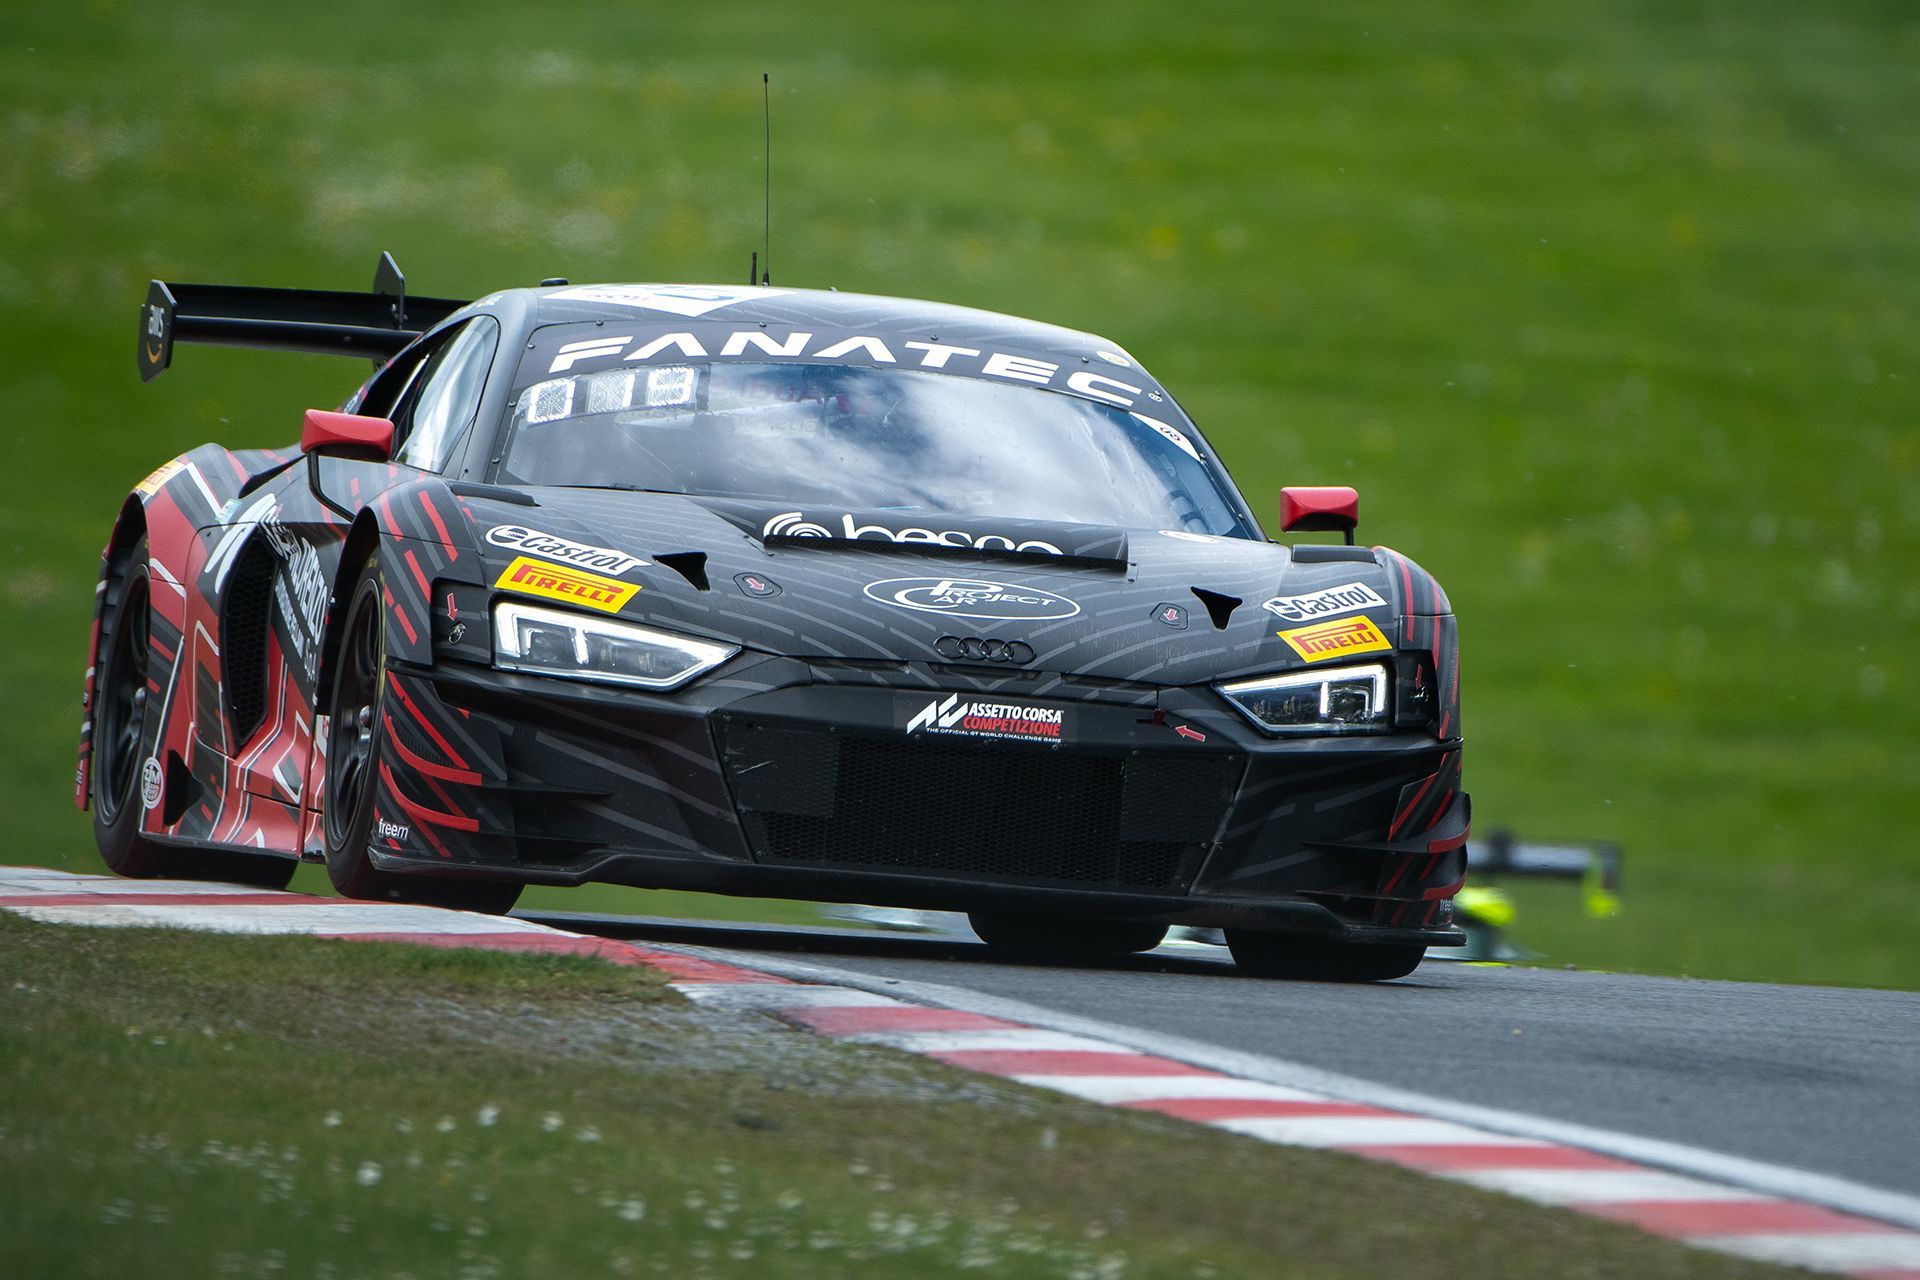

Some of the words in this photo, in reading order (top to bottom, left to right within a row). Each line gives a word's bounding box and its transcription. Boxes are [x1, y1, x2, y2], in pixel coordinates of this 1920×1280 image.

[548, 331, 1142, 406] FANATEC
[520, 536, 633, 571] Castrol
[511, 564, 624, 604] PIRELLI
[930, 581, 1057, 606] PROJECT
[1291, 586, 1378, 615] Castrol
[1291, 623, 1379, 655] PIRELLI
[963, 715, 1062, 737] COMPETIZIONE
[968, 702, 1023, 721] ASSETTO
[1022, 706, 1062, 724] CORSA
[940, 728, 969, 736] OFFICIAL
[1003, 733, 1042, 742] CHALLENGE
[378, 818, 409, 839] freem
